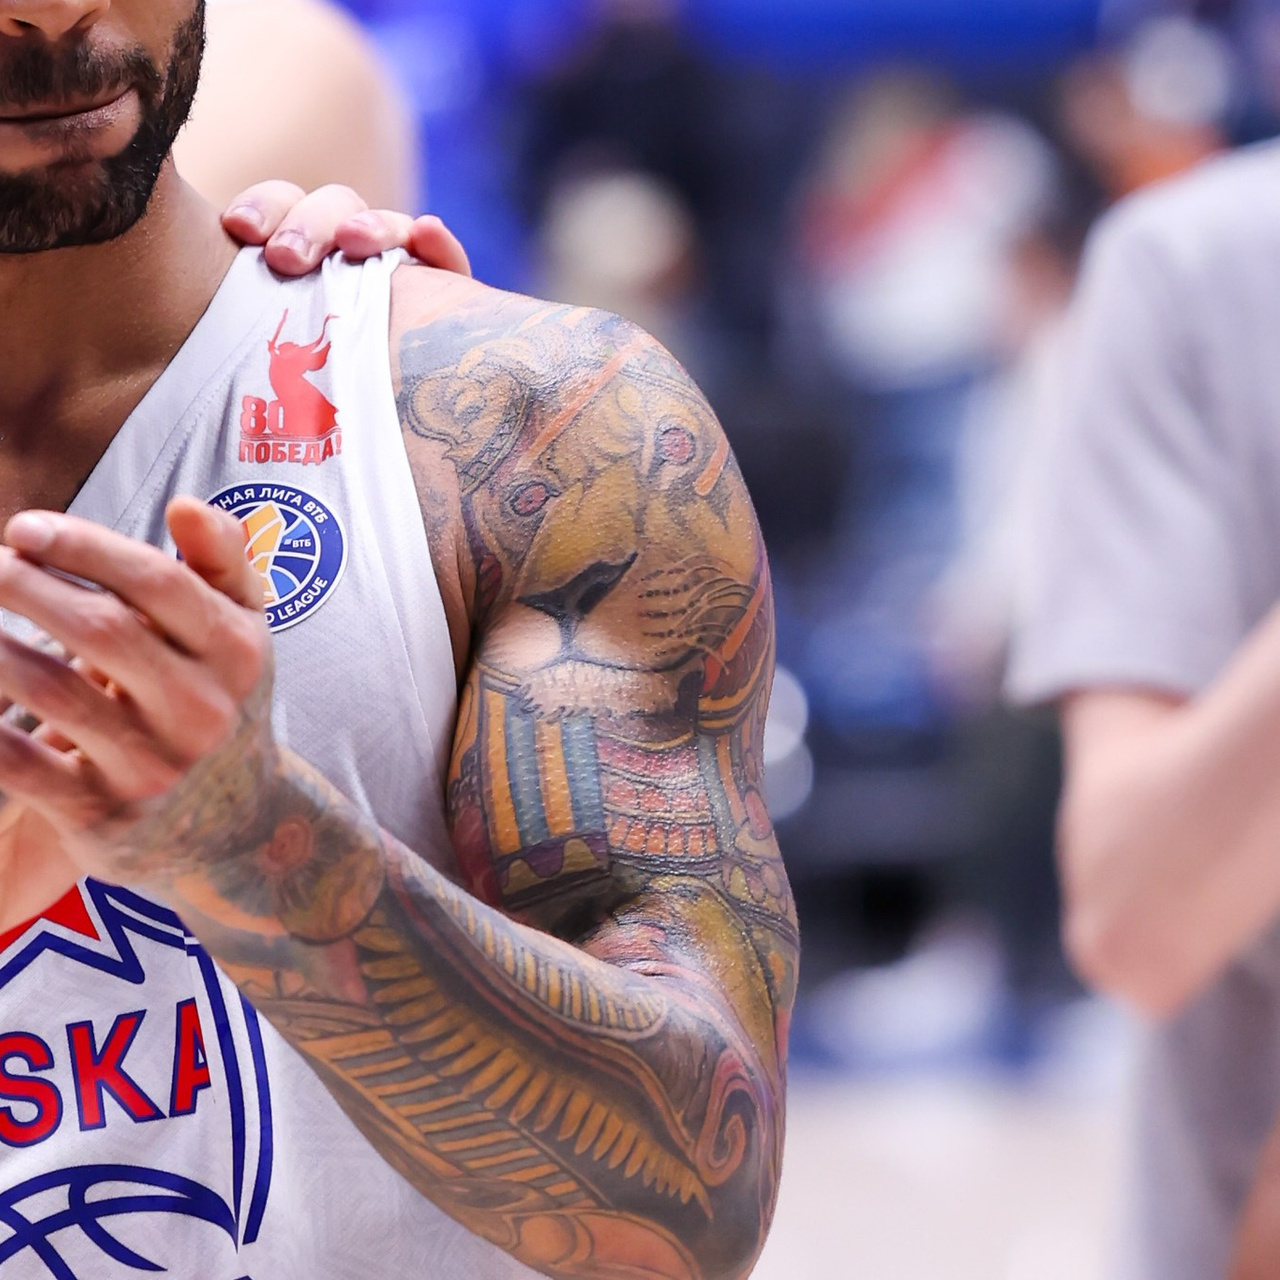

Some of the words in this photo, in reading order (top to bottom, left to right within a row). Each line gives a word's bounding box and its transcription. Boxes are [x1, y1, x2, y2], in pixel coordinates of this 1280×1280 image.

[239, 433, 342, 466] ПОБЕДА!
[259, 487, 302, 507] ЛИГА
[303, 501, 329, 524] ВТБ
[292, 538, 312, 548] ВТБ
[277, 576, 328, 621] LEAGUE
